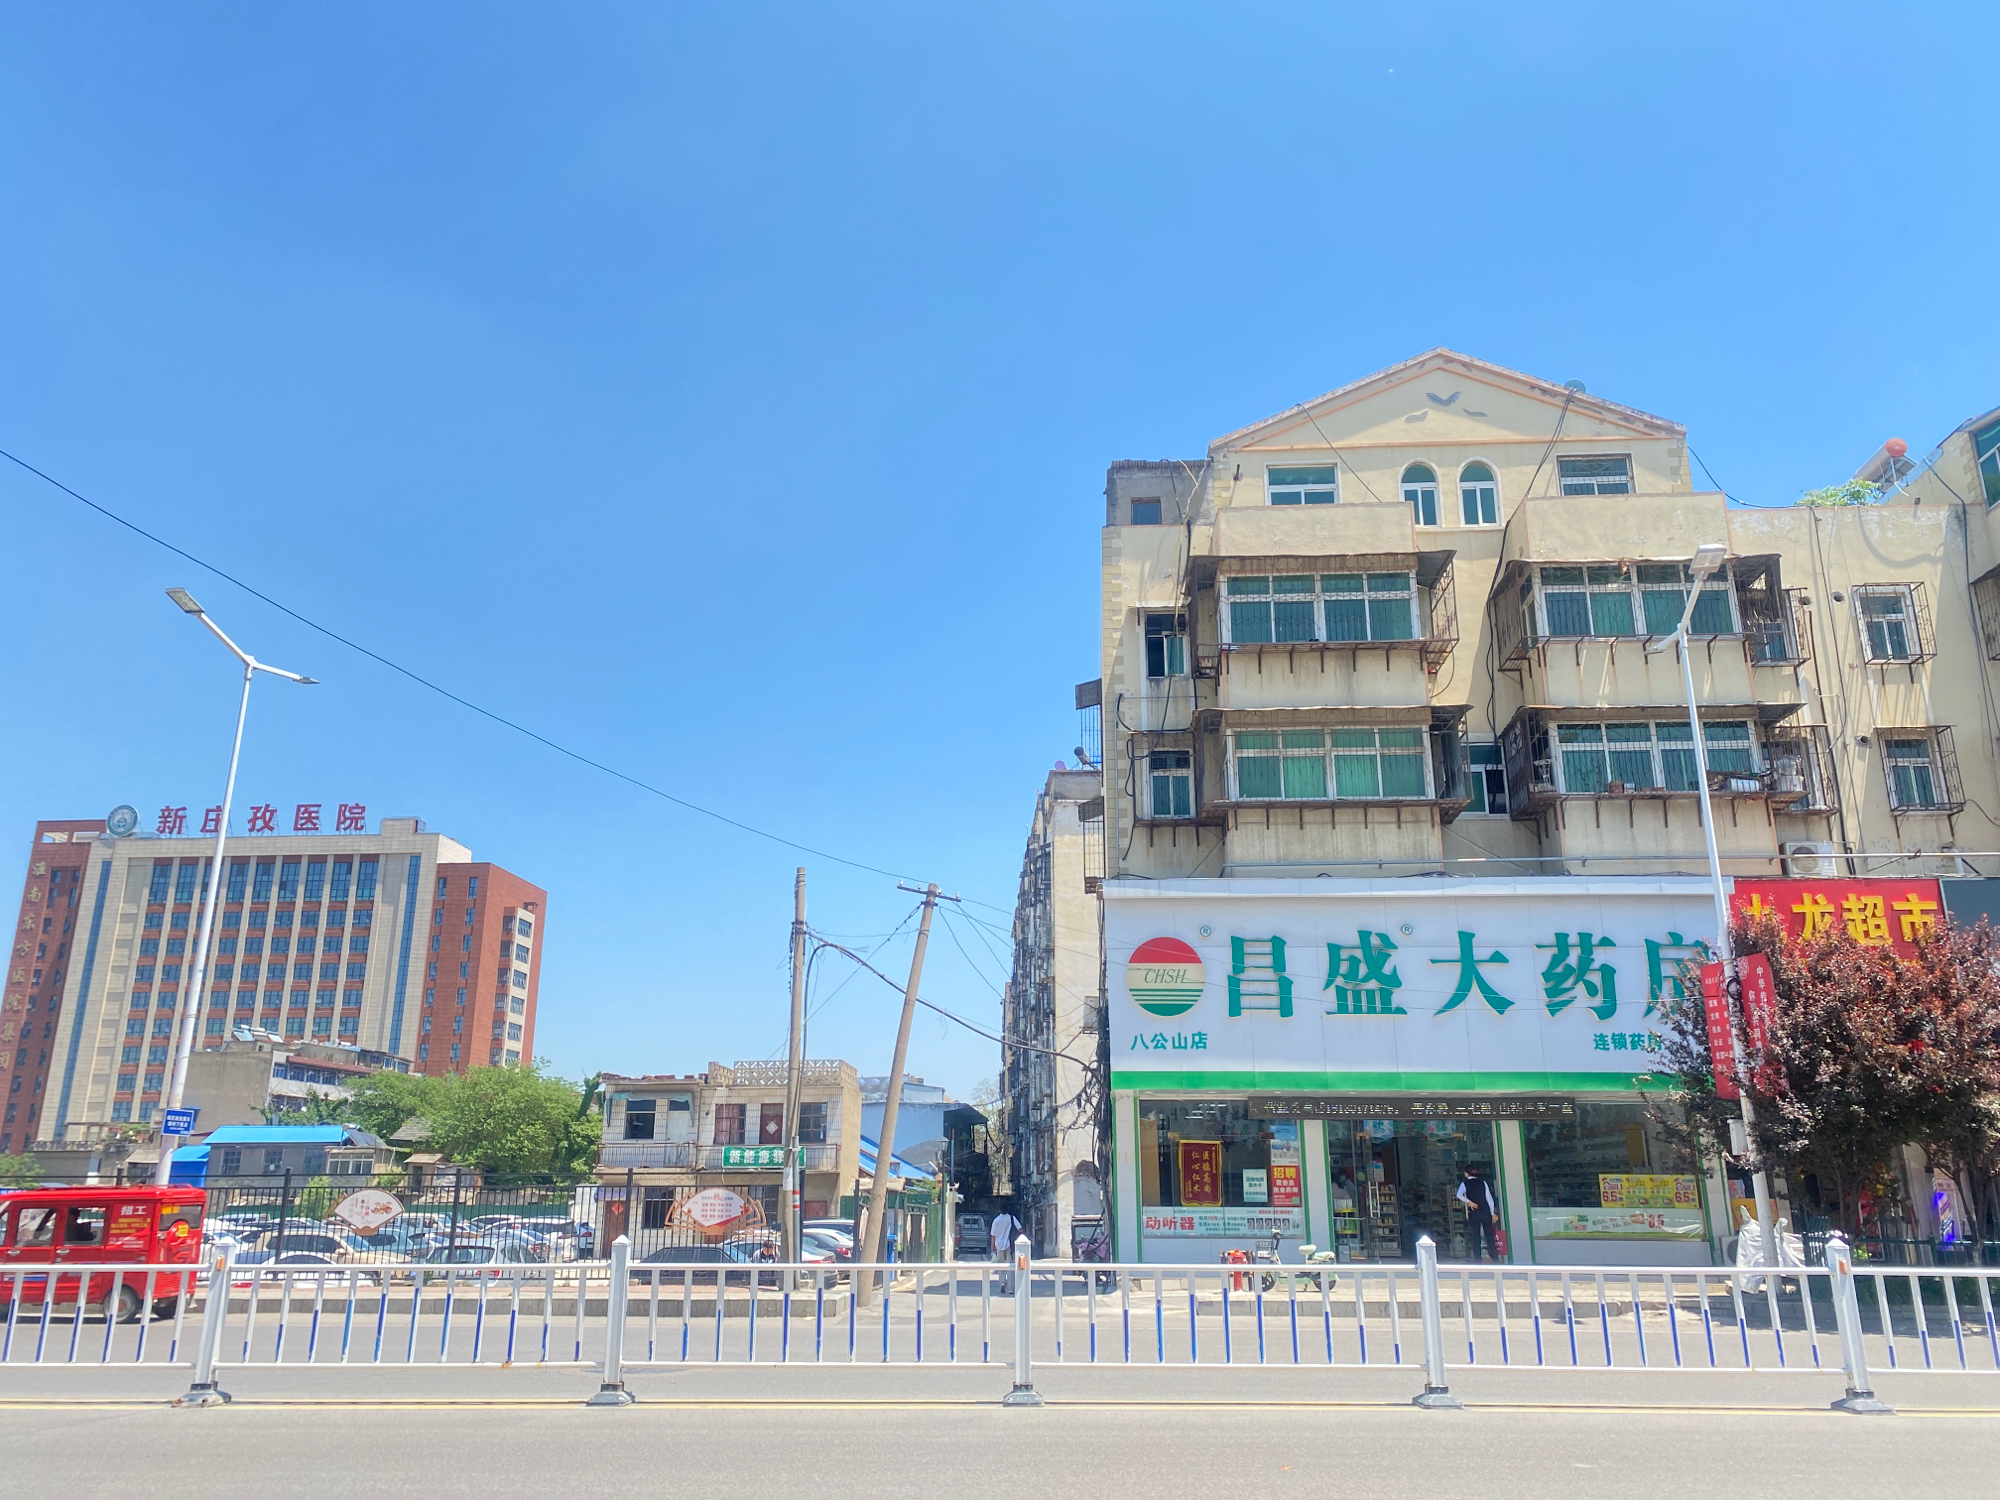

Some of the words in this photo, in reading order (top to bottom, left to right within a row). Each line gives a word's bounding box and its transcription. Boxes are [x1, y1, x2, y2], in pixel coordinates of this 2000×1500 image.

[156, 803, 366, 834] 新庄孜医院
[1144, 968, 1187, 984] CHSH
[1130, 1031, 1208, 1050] 八公山店
[729, 1149, 787, 1164] 新能源驿
[1273, 1167, 1297, 1179] 招聘
[1145, 1216, 1195, 1231] 助听器
